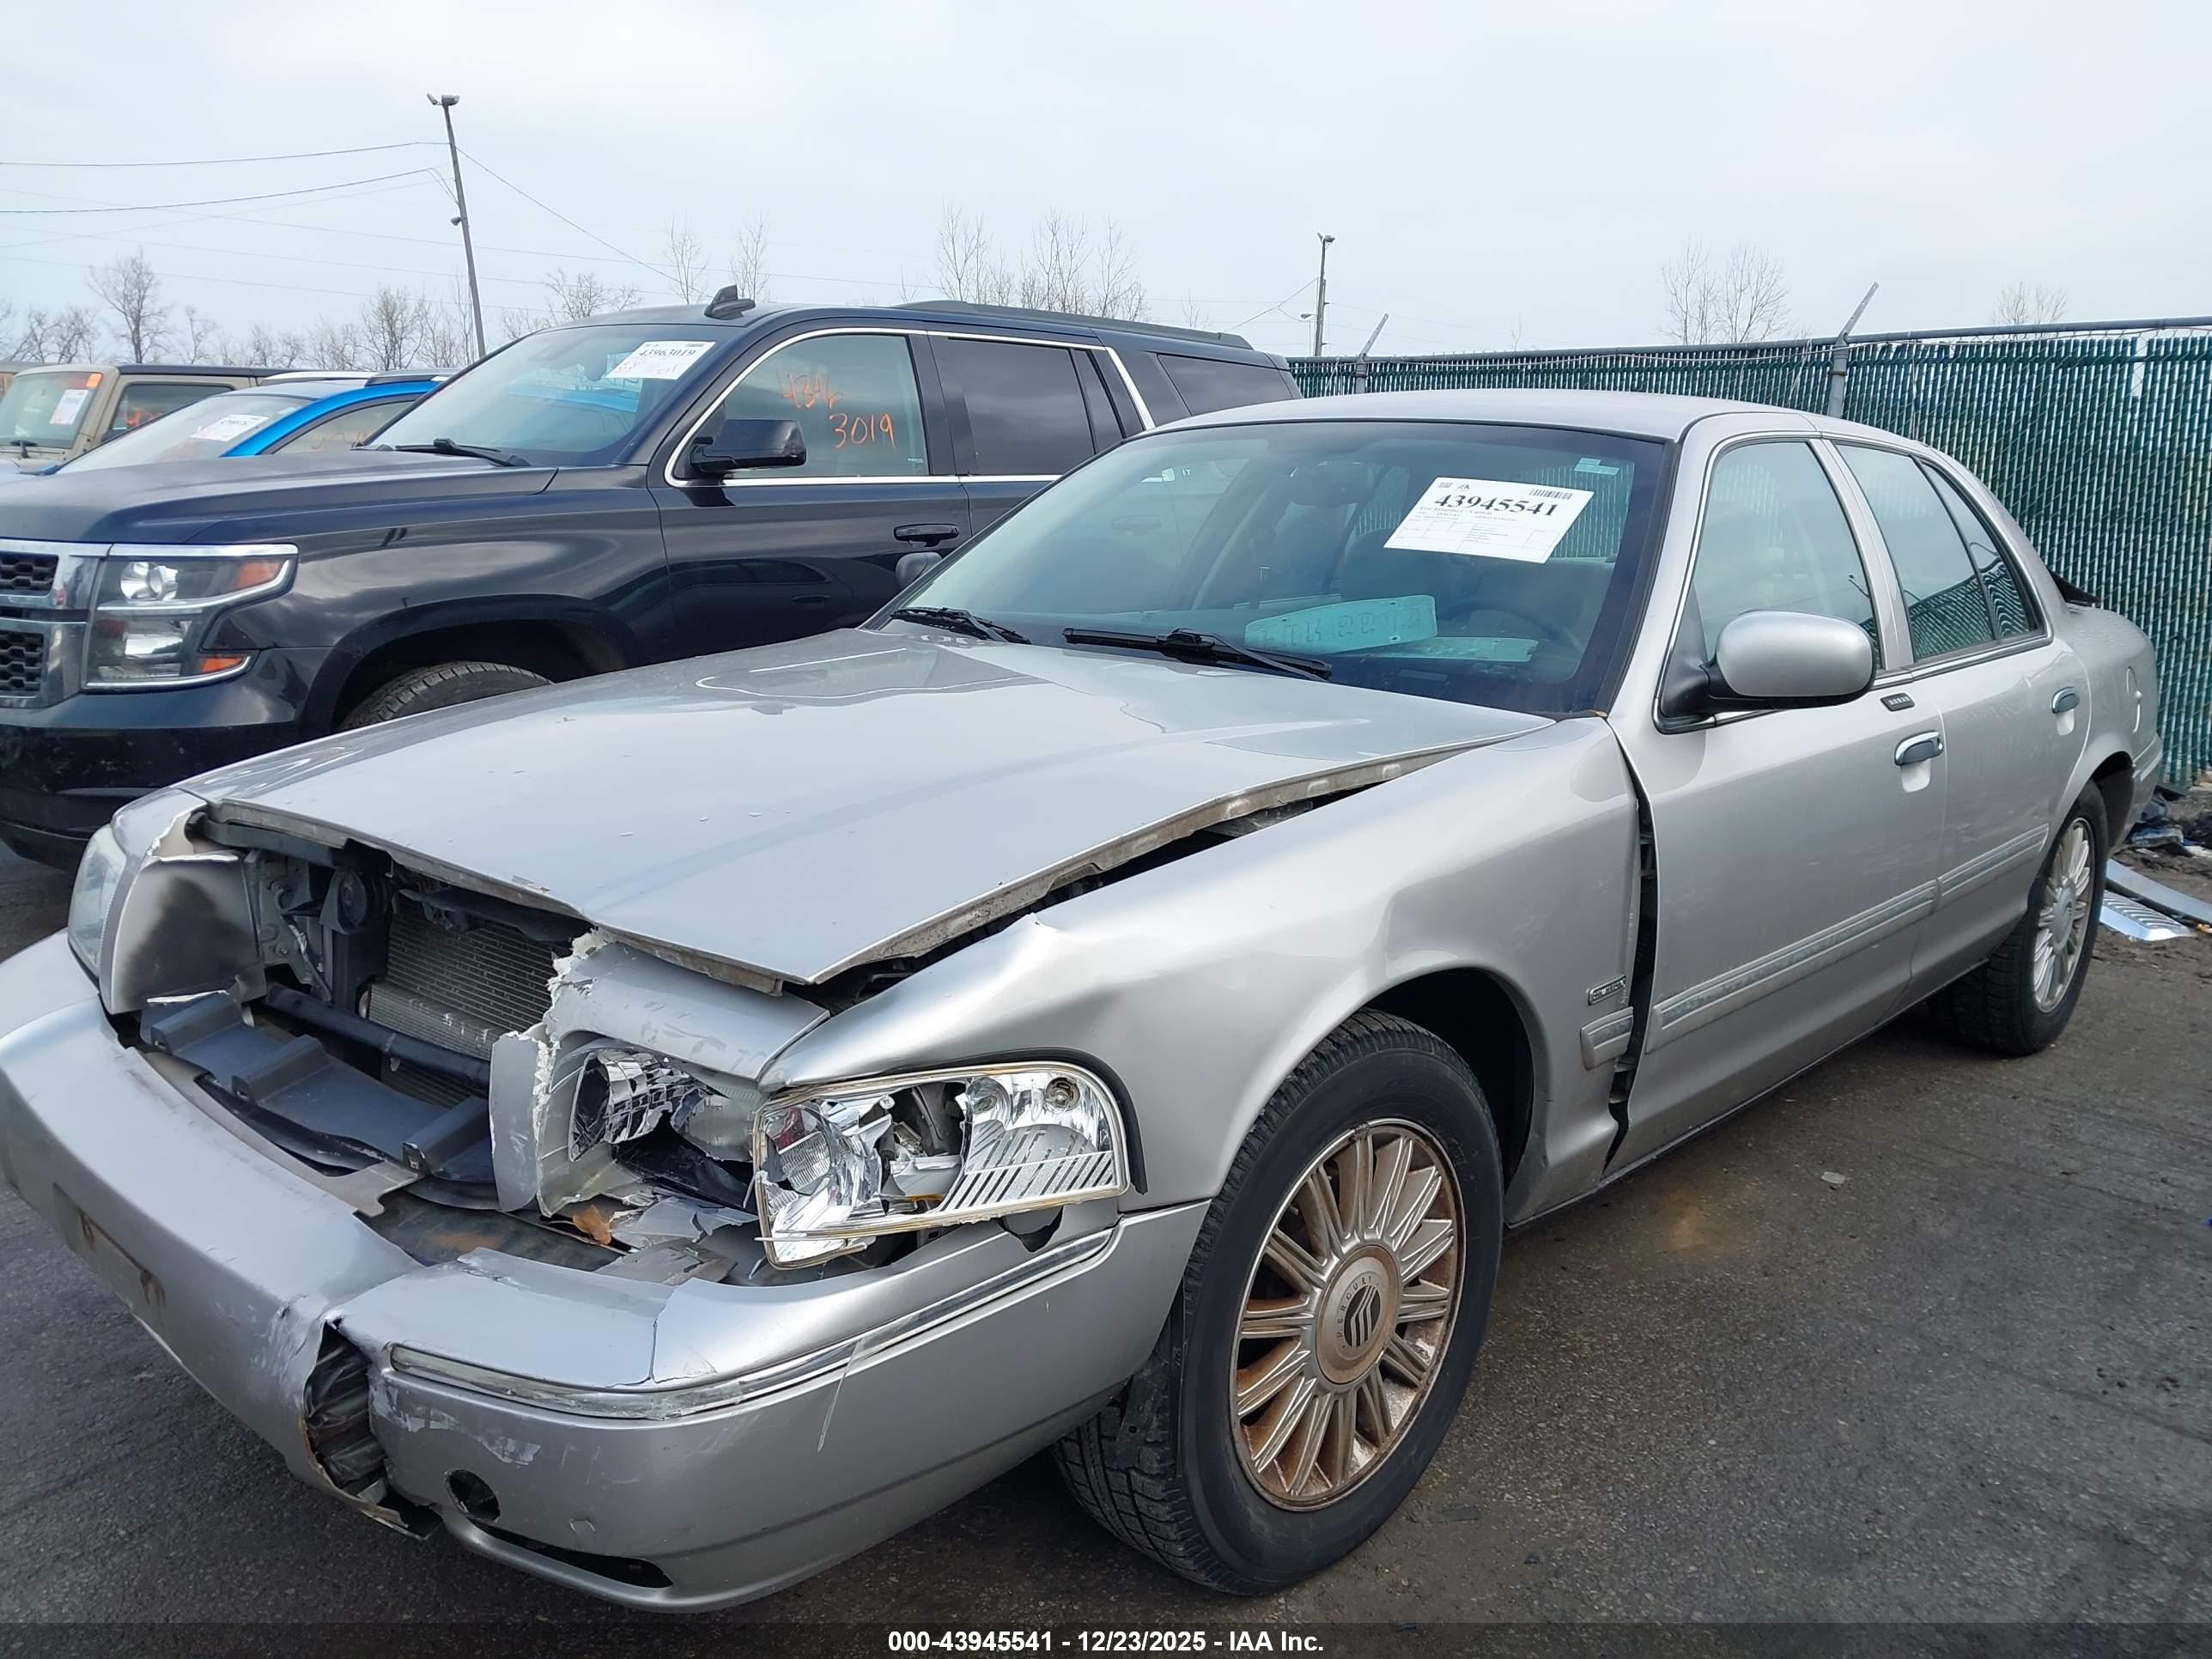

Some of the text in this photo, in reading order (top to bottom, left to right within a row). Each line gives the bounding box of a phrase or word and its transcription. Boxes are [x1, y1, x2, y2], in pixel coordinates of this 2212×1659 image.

[830, 412, 896, 450] 3019
[1435, 494, 1559, 516] 43945541
[1335, 1275, 1372, 1338] MERCURY
